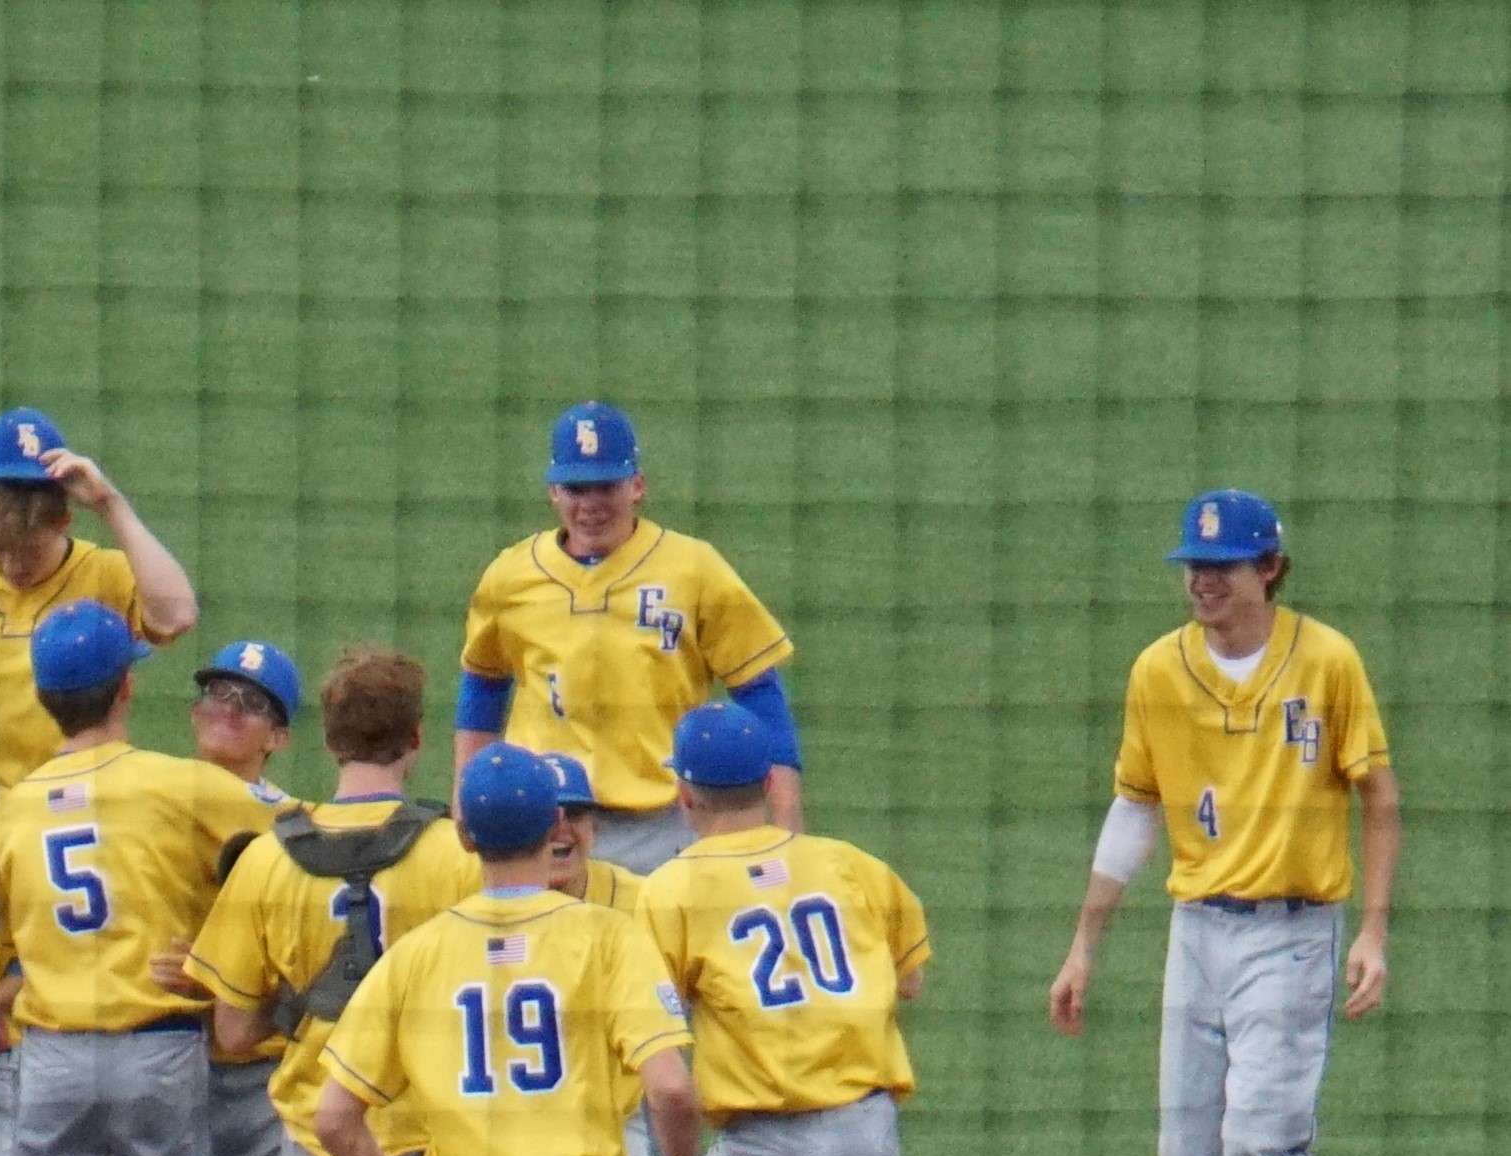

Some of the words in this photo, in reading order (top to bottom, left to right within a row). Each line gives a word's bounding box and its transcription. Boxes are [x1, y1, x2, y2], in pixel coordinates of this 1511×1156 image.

[1197, 787, 1219, 838] 4
[43, 824, 112, 933] 5
[729, 895, 858, 1008] 20
[455, 980, 567, 1096] 19
